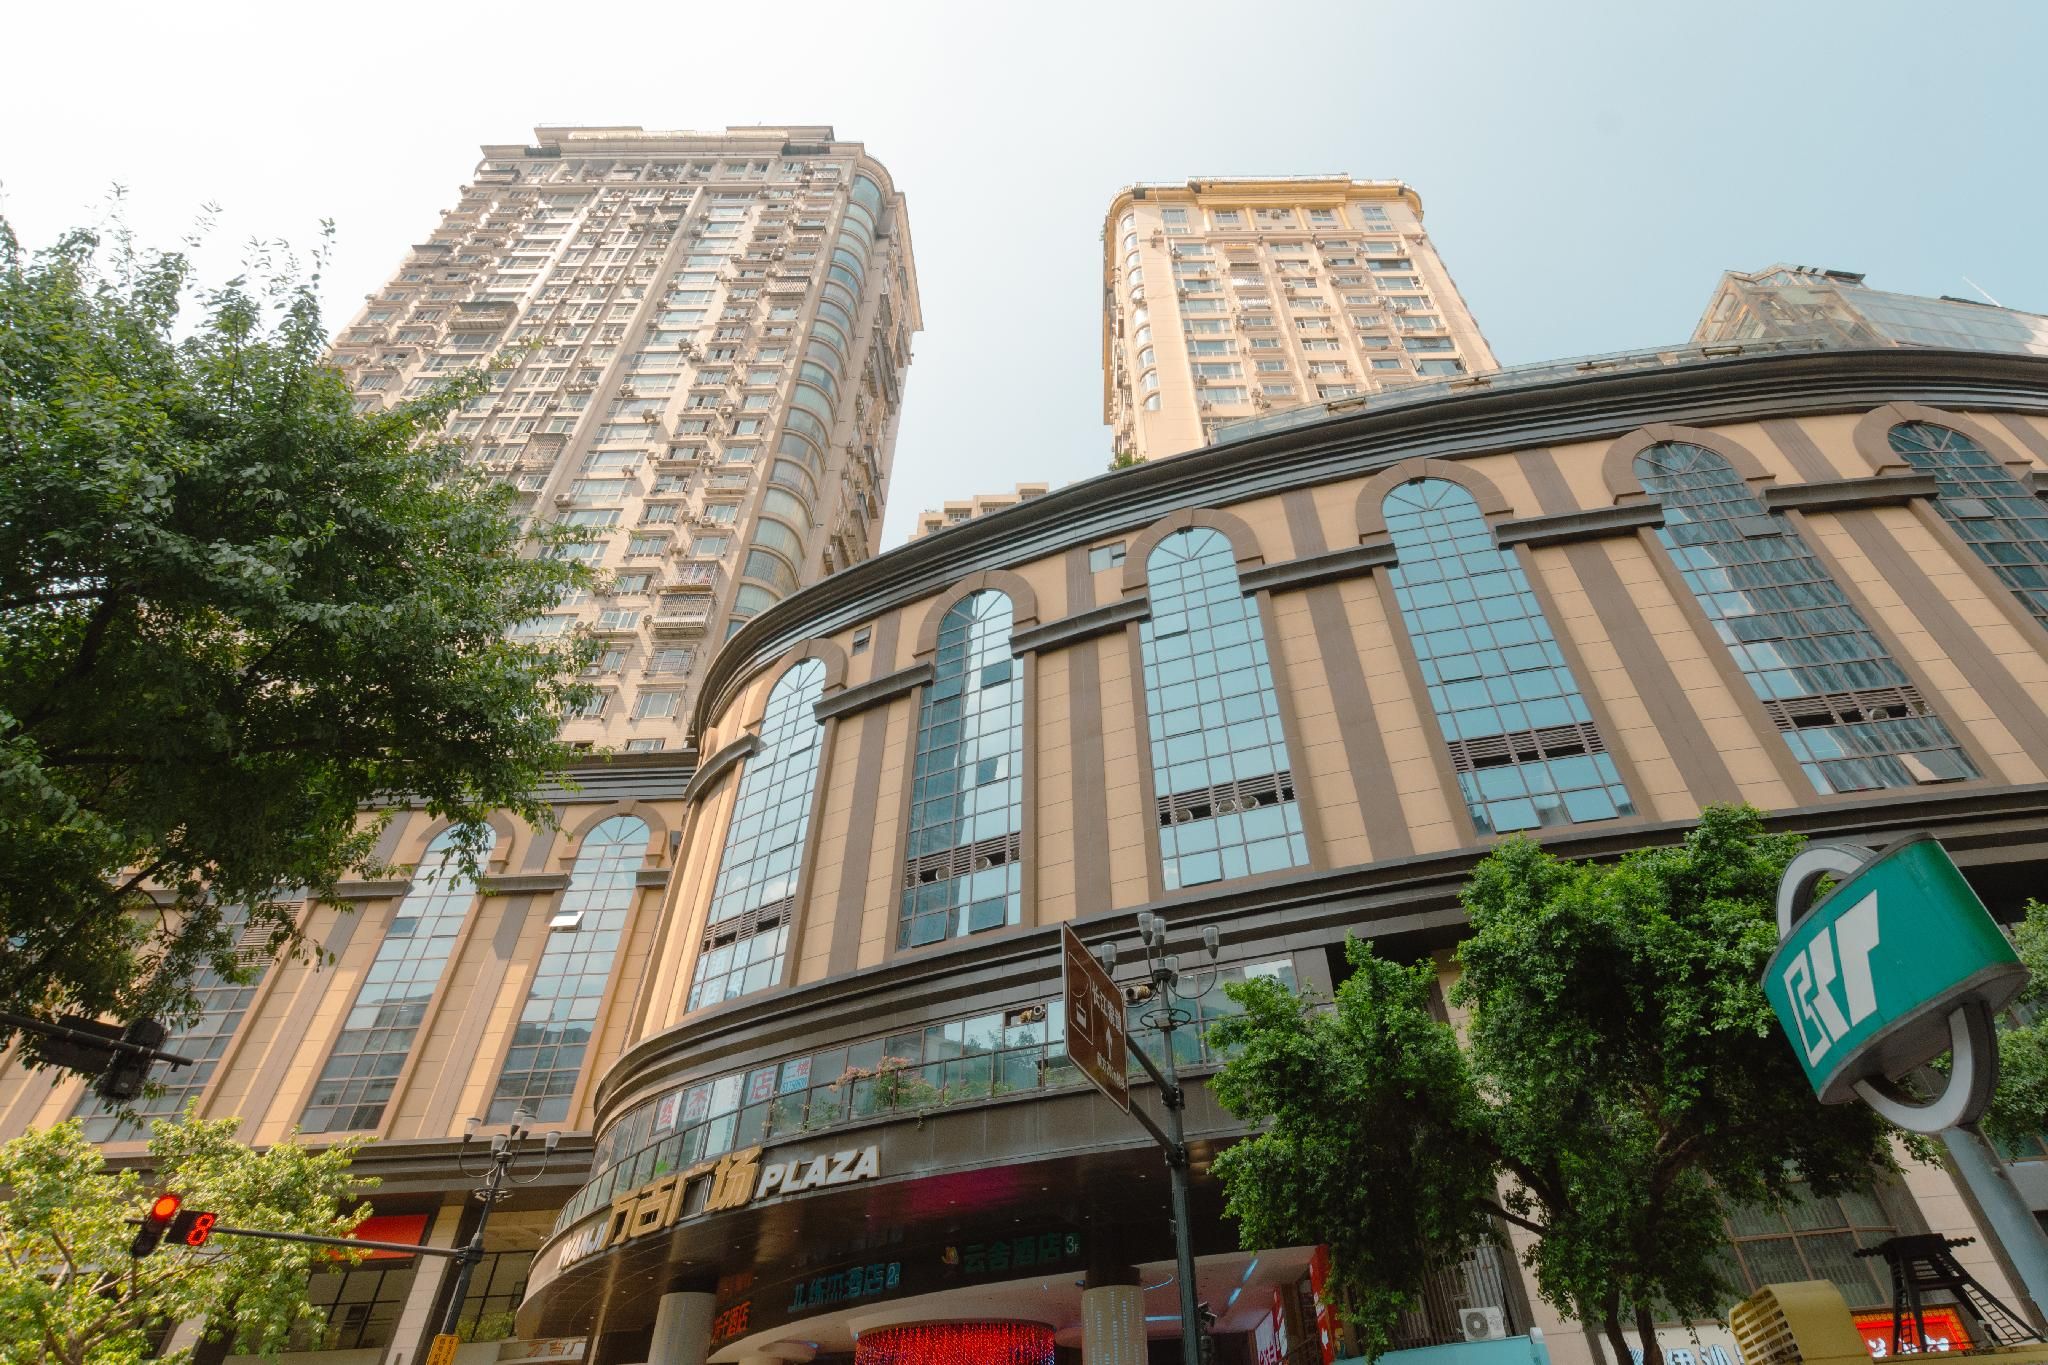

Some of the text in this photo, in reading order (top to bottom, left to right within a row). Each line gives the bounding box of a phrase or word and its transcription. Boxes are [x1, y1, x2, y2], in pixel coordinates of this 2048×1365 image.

[557, 1145, 880, 1270] WANJI 万吉广场 PLAZA
[187, 1213, 215, 1246] 8
[963, 1233, 1062, 1272] 云舍酒店
